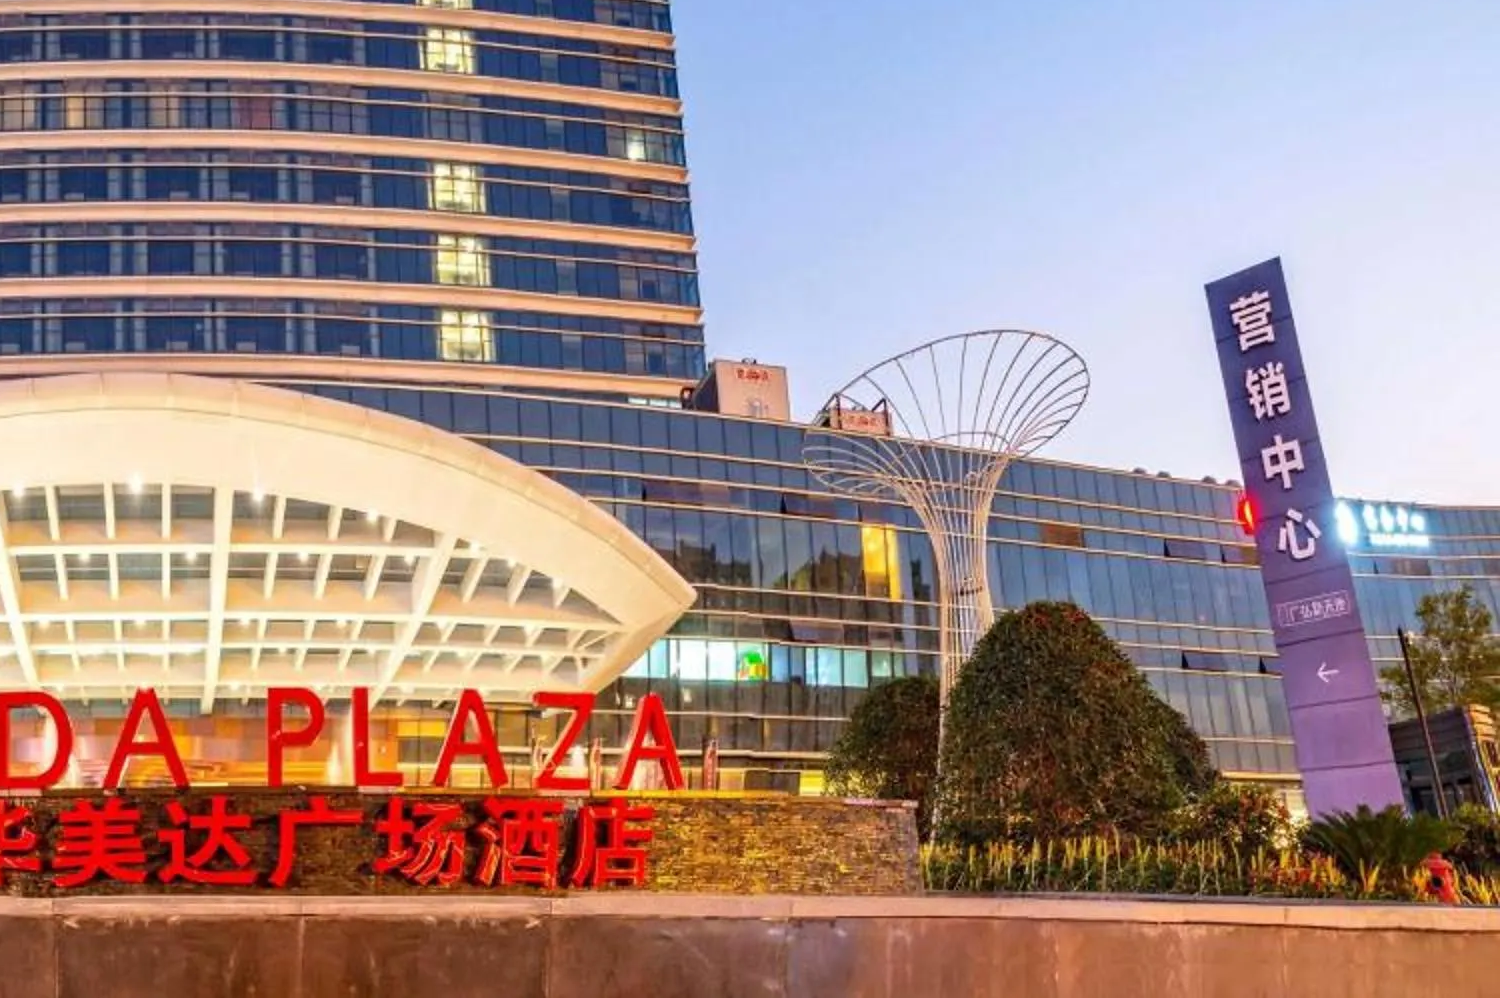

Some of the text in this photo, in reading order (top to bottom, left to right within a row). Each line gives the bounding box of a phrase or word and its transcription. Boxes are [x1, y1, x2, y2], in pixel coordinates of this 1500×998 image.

[1229, 290, 1321, 560] 营销中心
[267, 687, 685, 792] PLAZA
